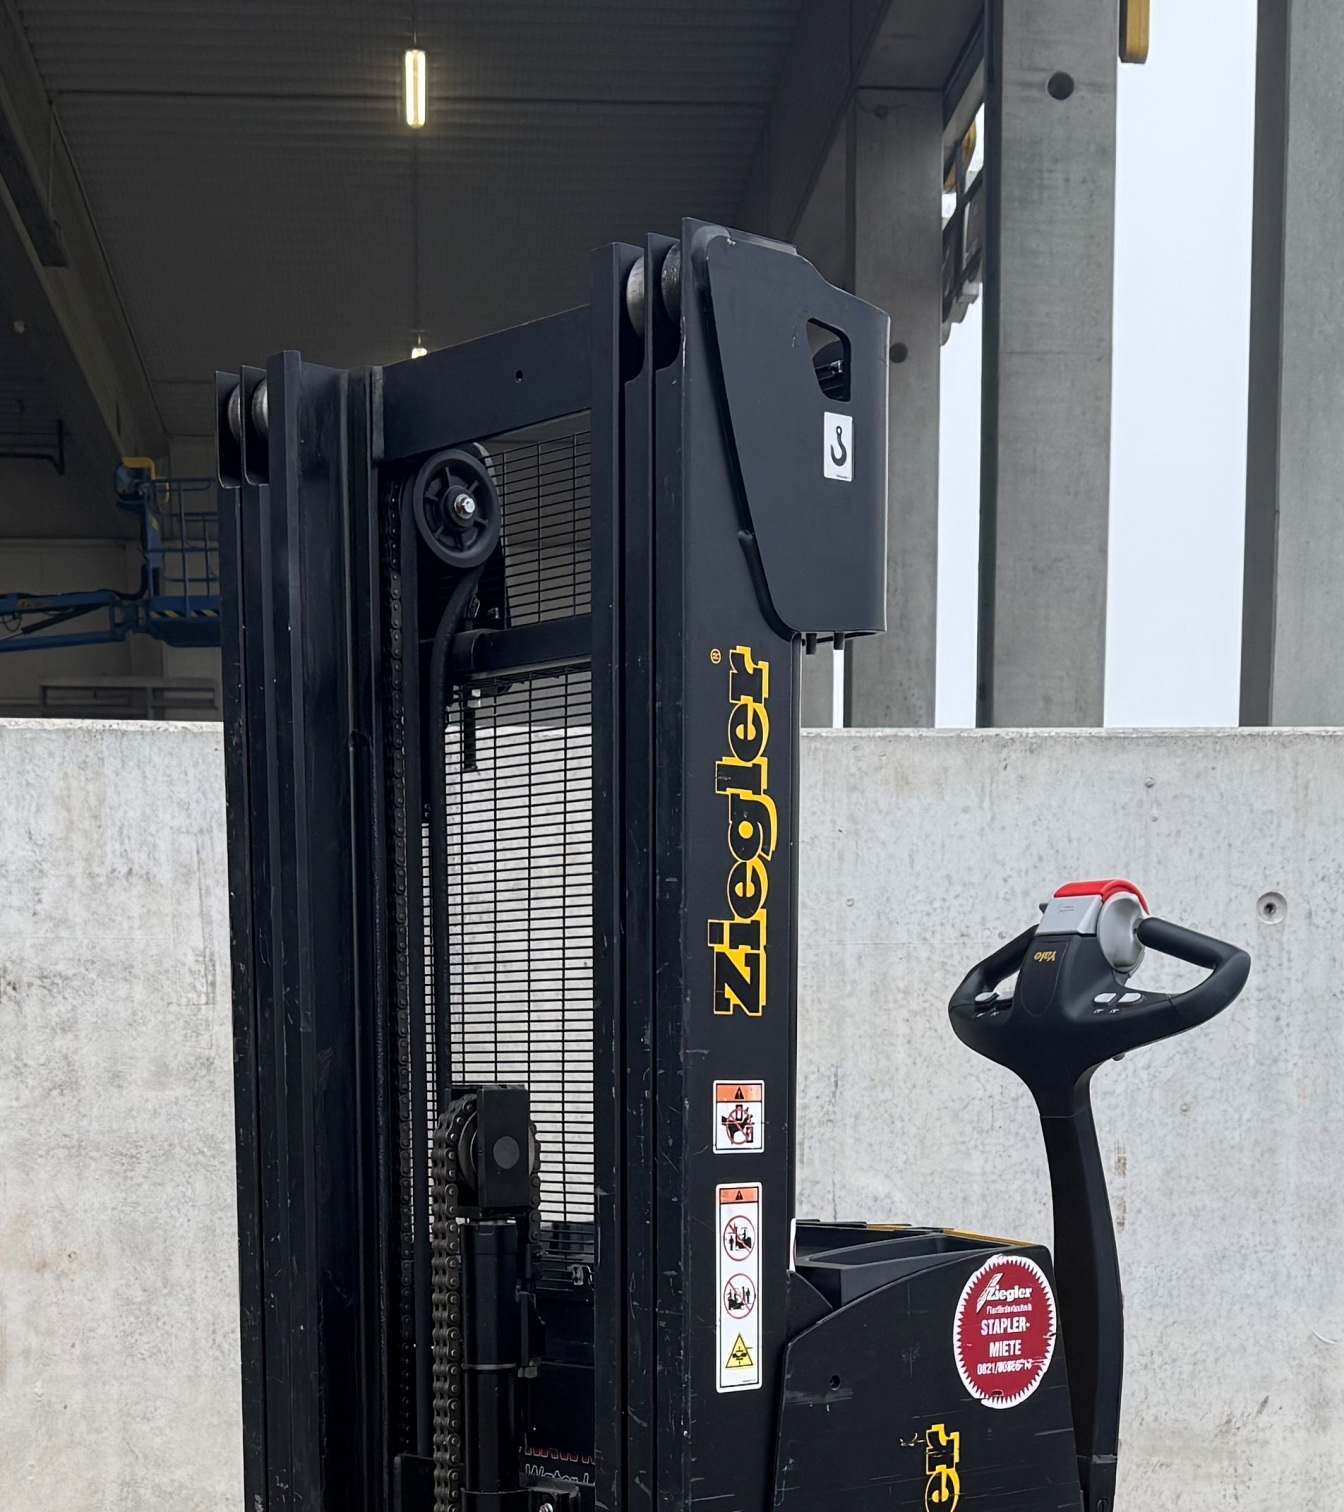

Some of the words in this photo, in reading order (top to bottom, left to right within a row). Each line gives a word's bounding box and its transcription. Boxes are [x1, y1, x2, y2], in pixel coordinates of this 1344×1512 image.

[707, 645, 778, 1017] Ziegler
[985, 1284, 1033, 1302] Ziegler
[981, 1316, 1031, 1336] STAPLER-
[989, 1339, 1022, 1358] MIETE
